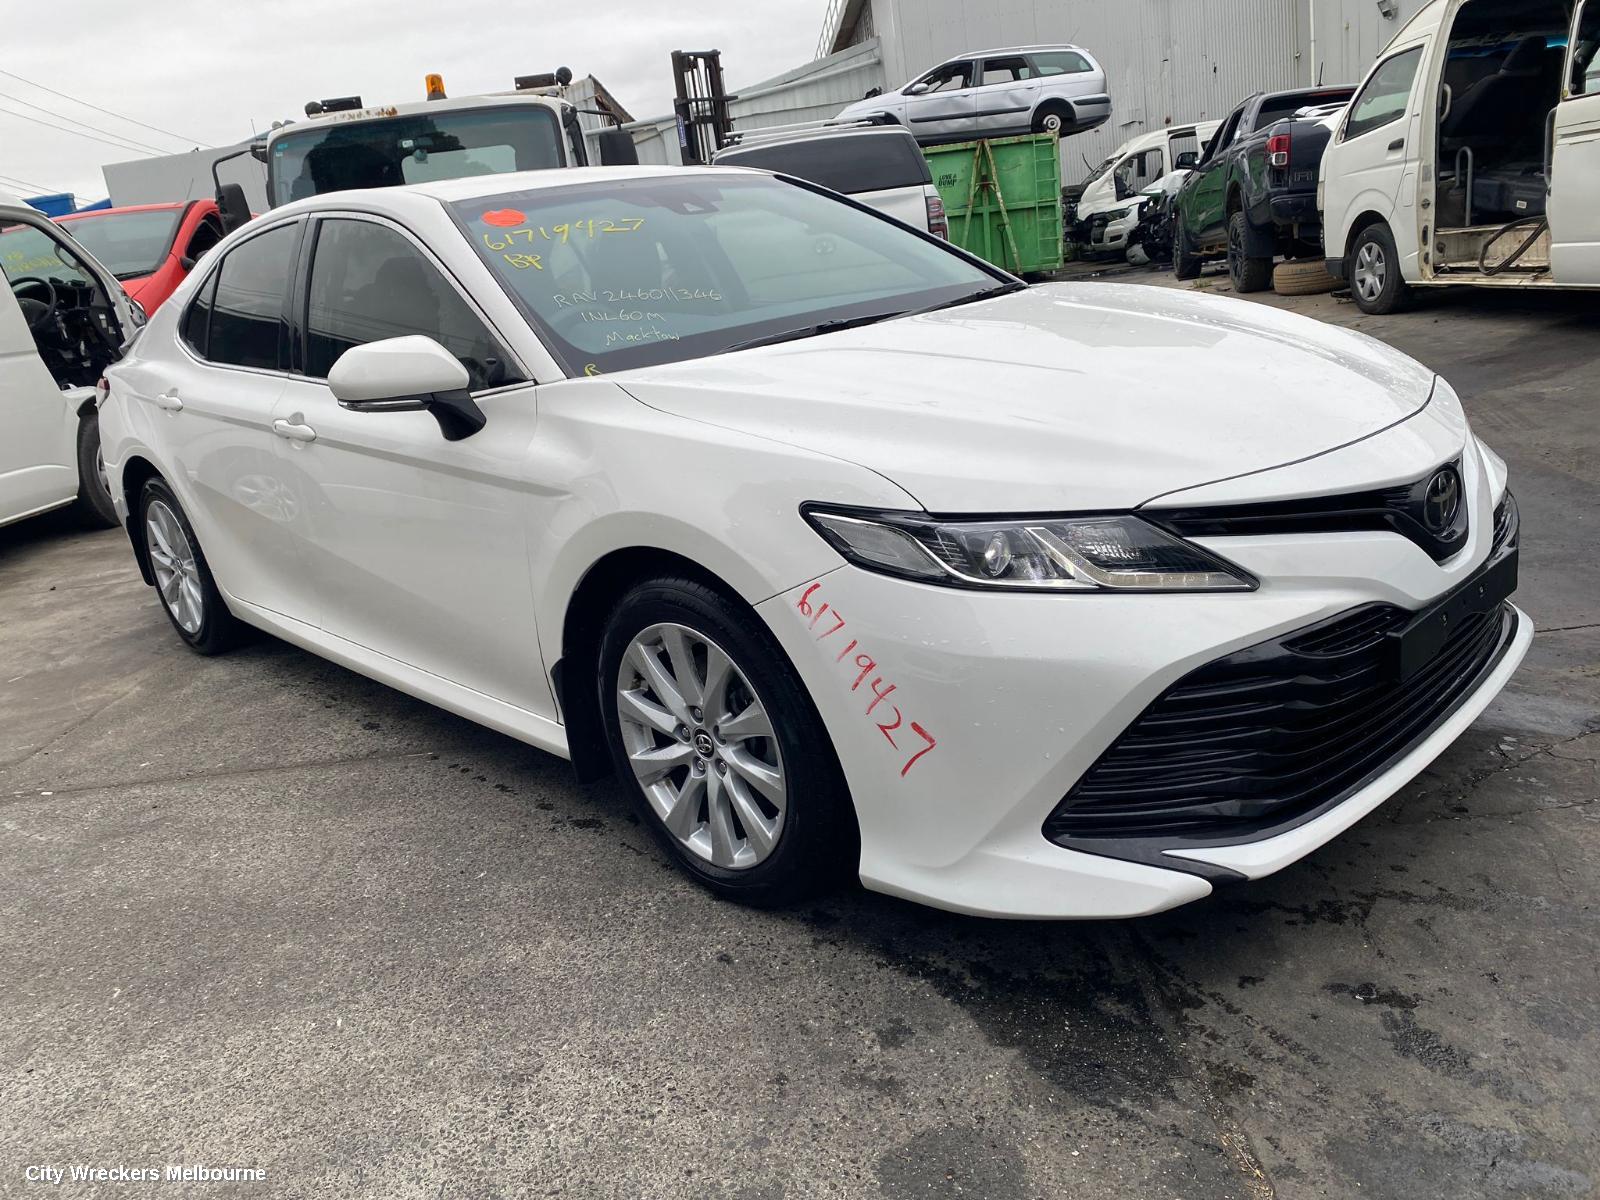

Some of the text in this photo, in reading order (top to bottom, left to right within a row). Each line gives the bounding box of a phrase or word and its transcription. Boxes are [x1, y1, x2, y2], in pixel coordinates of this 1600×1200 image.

[484, 217, 646, 251] 61719427
[553, 288, 598, 308] RAV
[796, 582, 938, 779] 61719427
